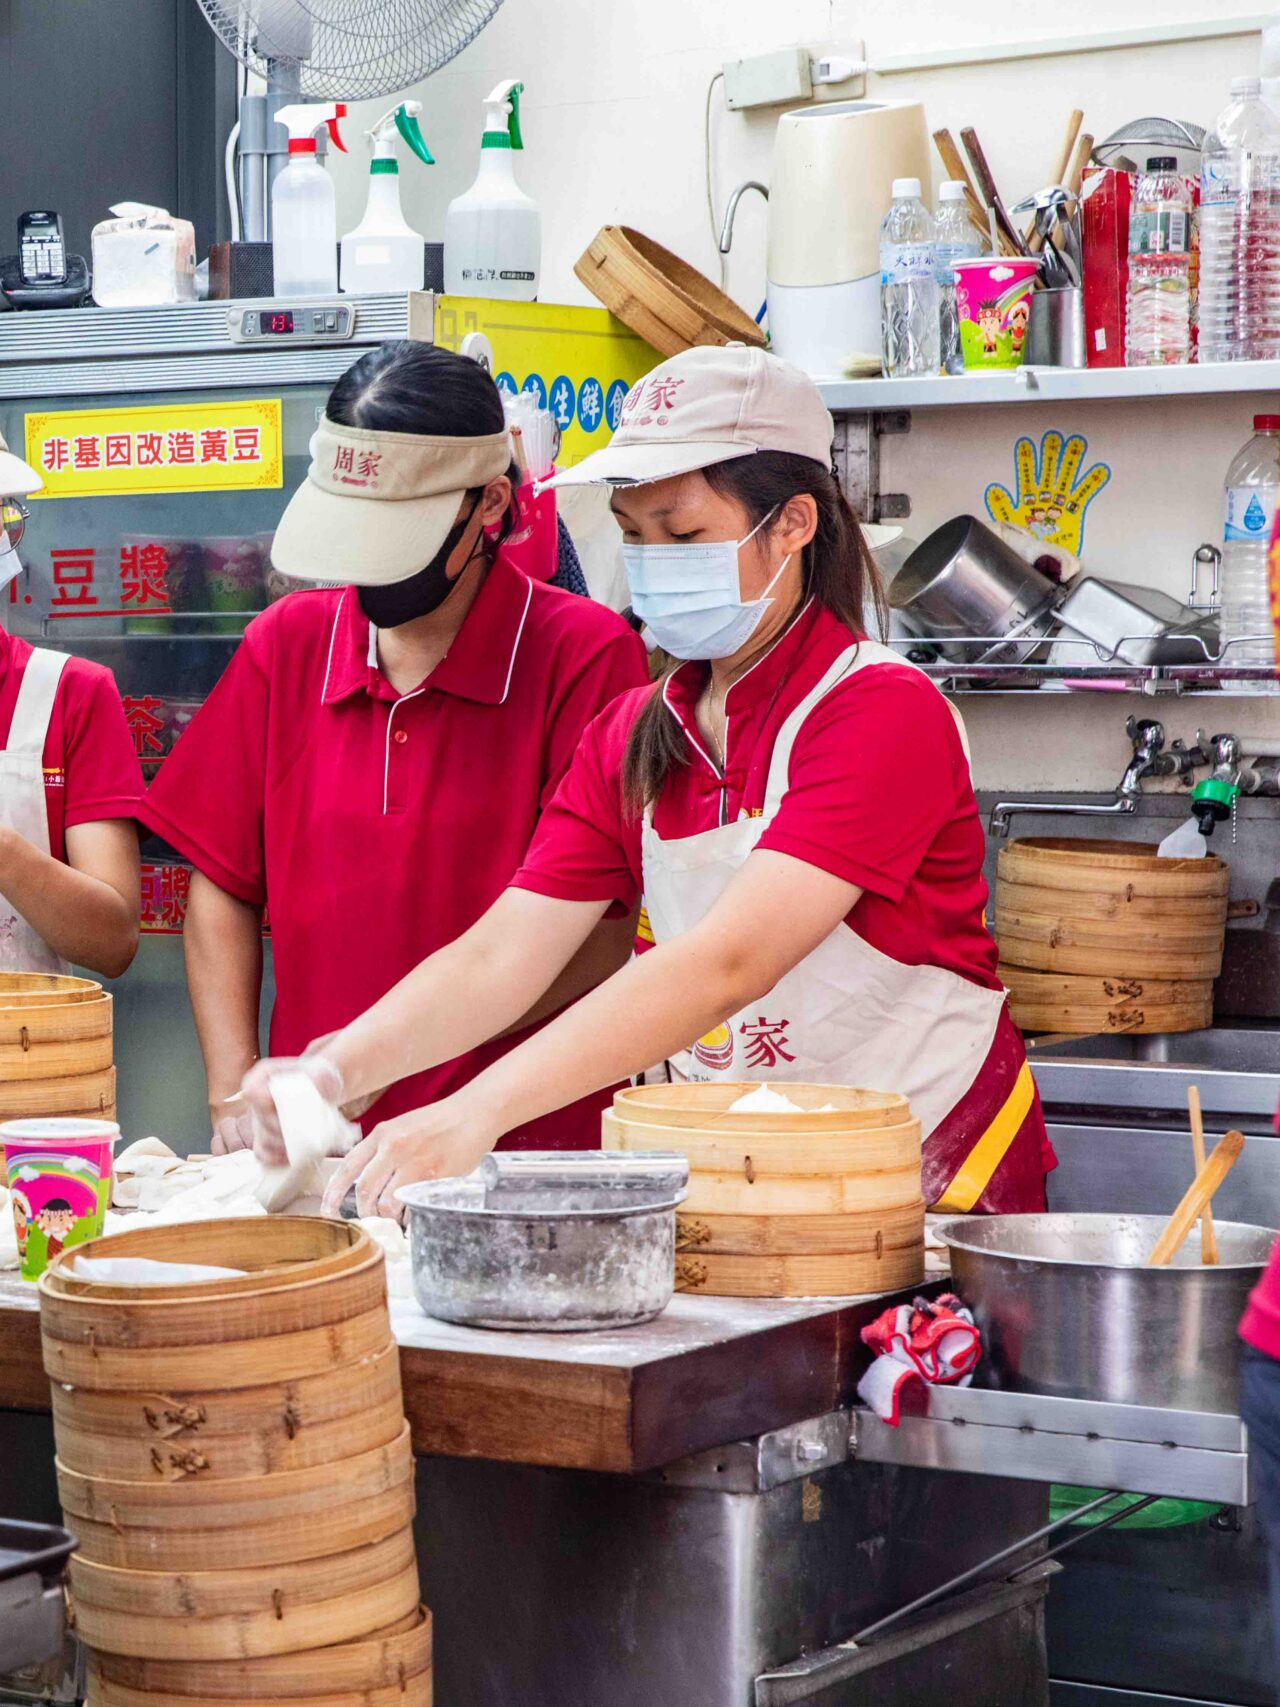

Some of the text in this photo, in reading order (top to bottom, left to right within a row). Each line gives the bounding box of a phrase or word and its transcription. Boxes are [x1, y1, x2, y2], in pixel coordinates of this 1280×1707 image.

[43, 428, 261, 470] 非基因改造黃豆
[333, 445, 382, 476] 周家
[50, 543, 170, 604] 豆漿
[739, 1016, 797, 1068] 家
